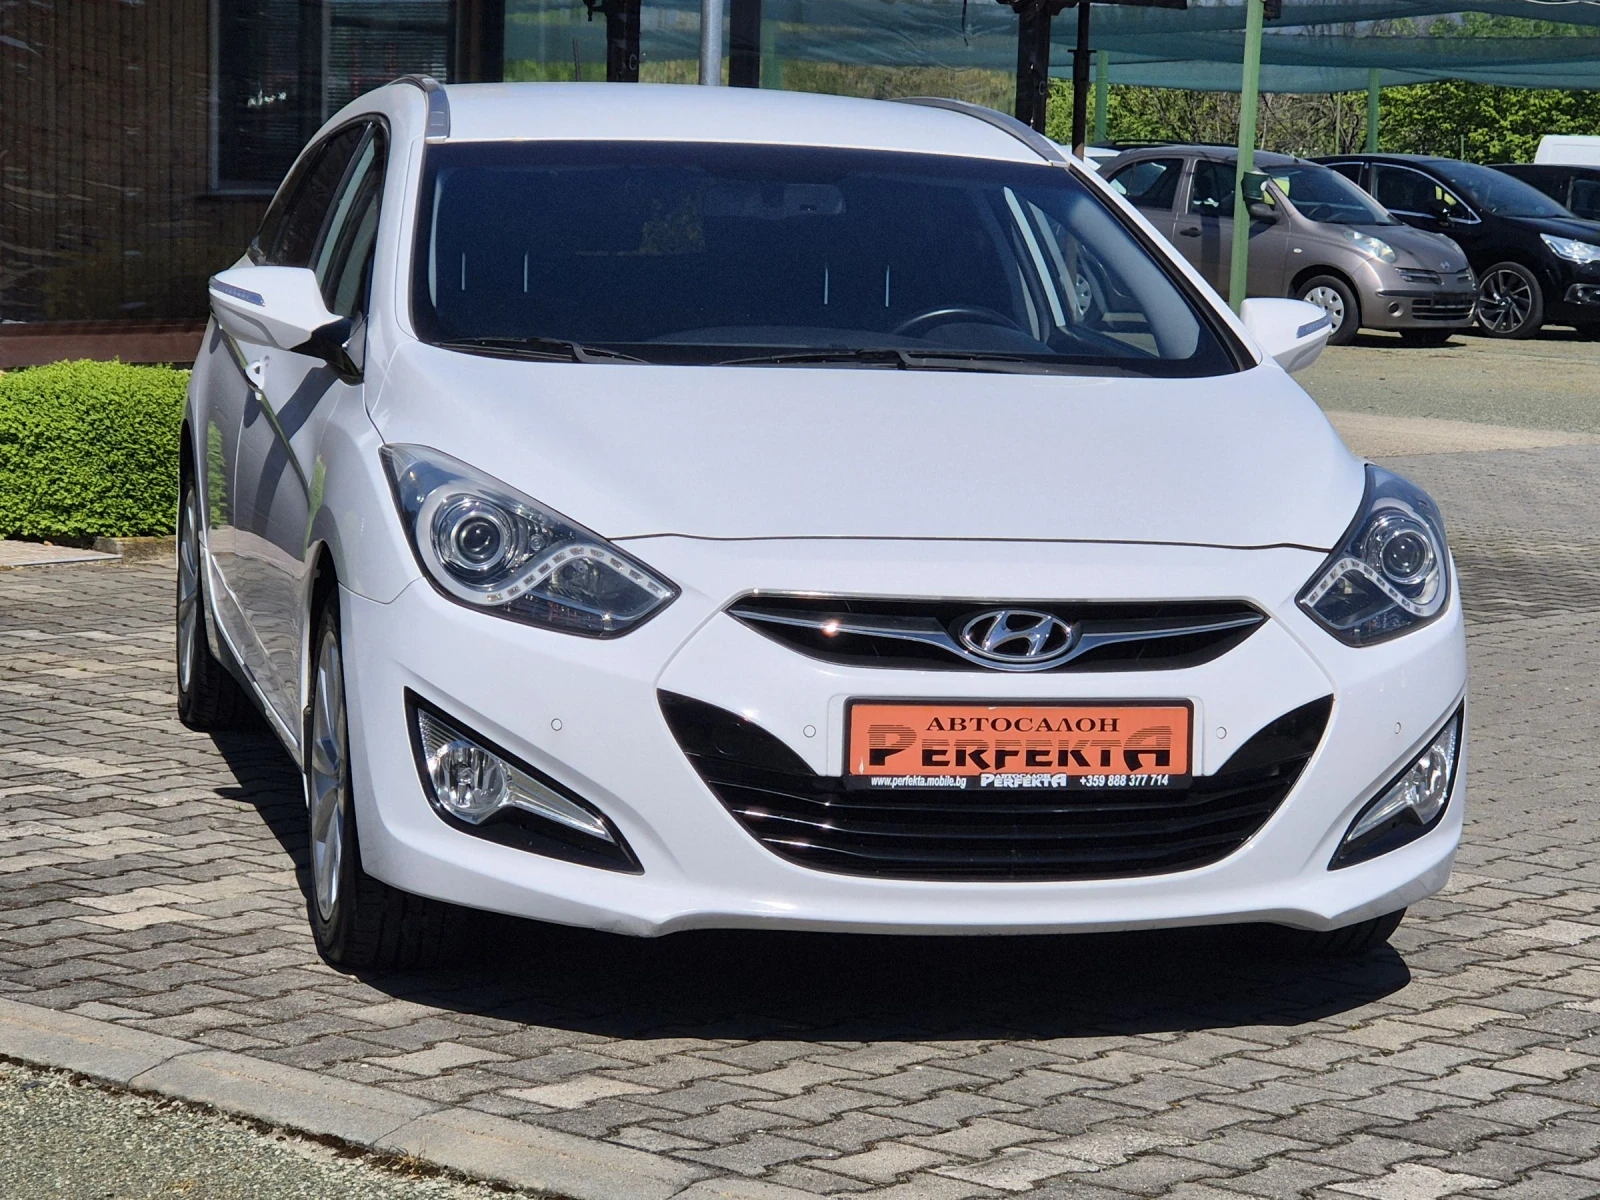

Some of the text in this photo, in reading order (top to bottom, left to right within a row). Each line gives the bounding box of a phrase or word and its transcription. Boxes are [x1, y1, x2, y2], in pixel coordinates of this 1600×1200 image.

[926, 717, 1120, 733] АВТОСАЛОН
[871, 775, 967, 789] www.perfekta.mobile.bg
[1079, 774, 1169, 787] +359 888 377 714
